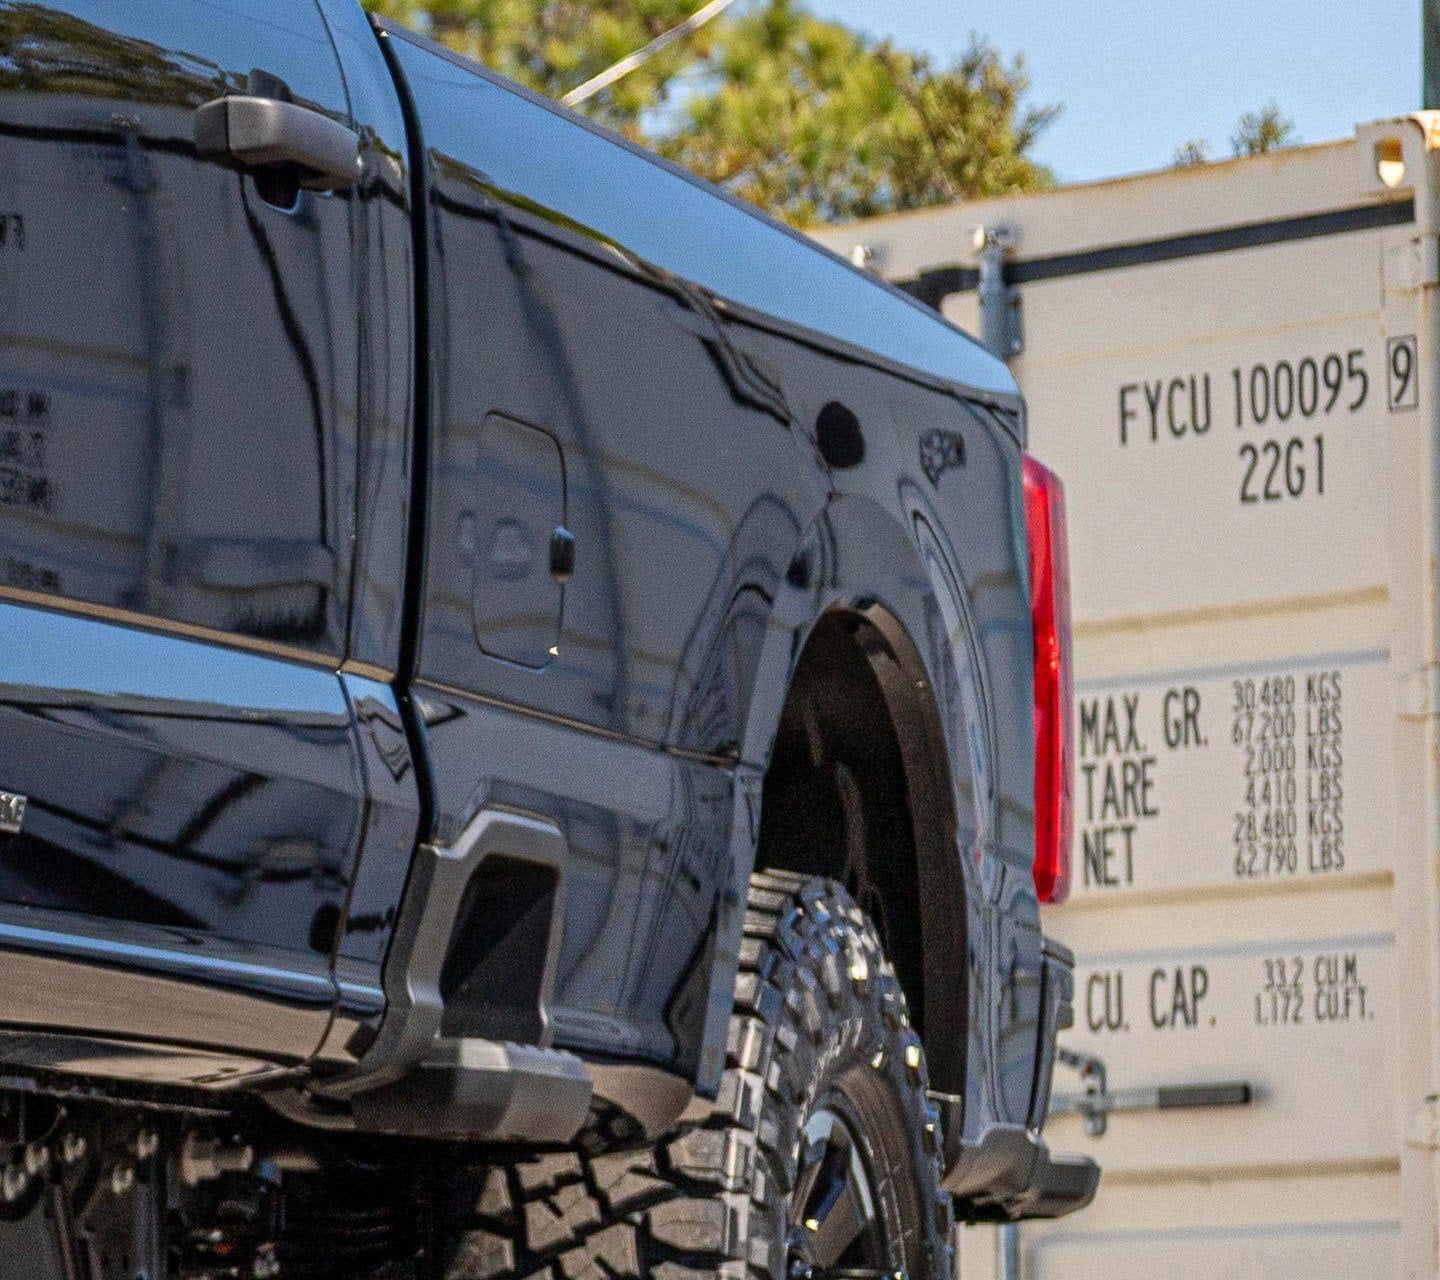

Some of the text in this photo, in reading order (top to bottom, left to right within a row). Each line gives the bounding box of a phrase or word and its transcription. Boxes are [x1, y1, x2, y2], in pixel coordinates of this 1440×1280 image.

[1119, 343, 1412, 445] FYCU 100095 9
[1239, 432, 1325, 504] 22G1
[1080, 692, 1147, 757] MAX.
[1163, 685, 1209, 750] GR.
[1306, 670, 1342, 703] KGS
[1307, 704, 1342, 737] LBS
[1082, 755, 1160, 821] TARE
[1307, 737, 1343, 770] KGS
[1308, 770, 1344, 803] LBS
[1083, 822, 1137, 888] NET
[1309, 803, 1345, 837] KGS
[1310, 837, 1346, 872] LBS
[1086, 971, 1130, 1033] CU.
[1149, 965, 1217, 1029] CAP.
